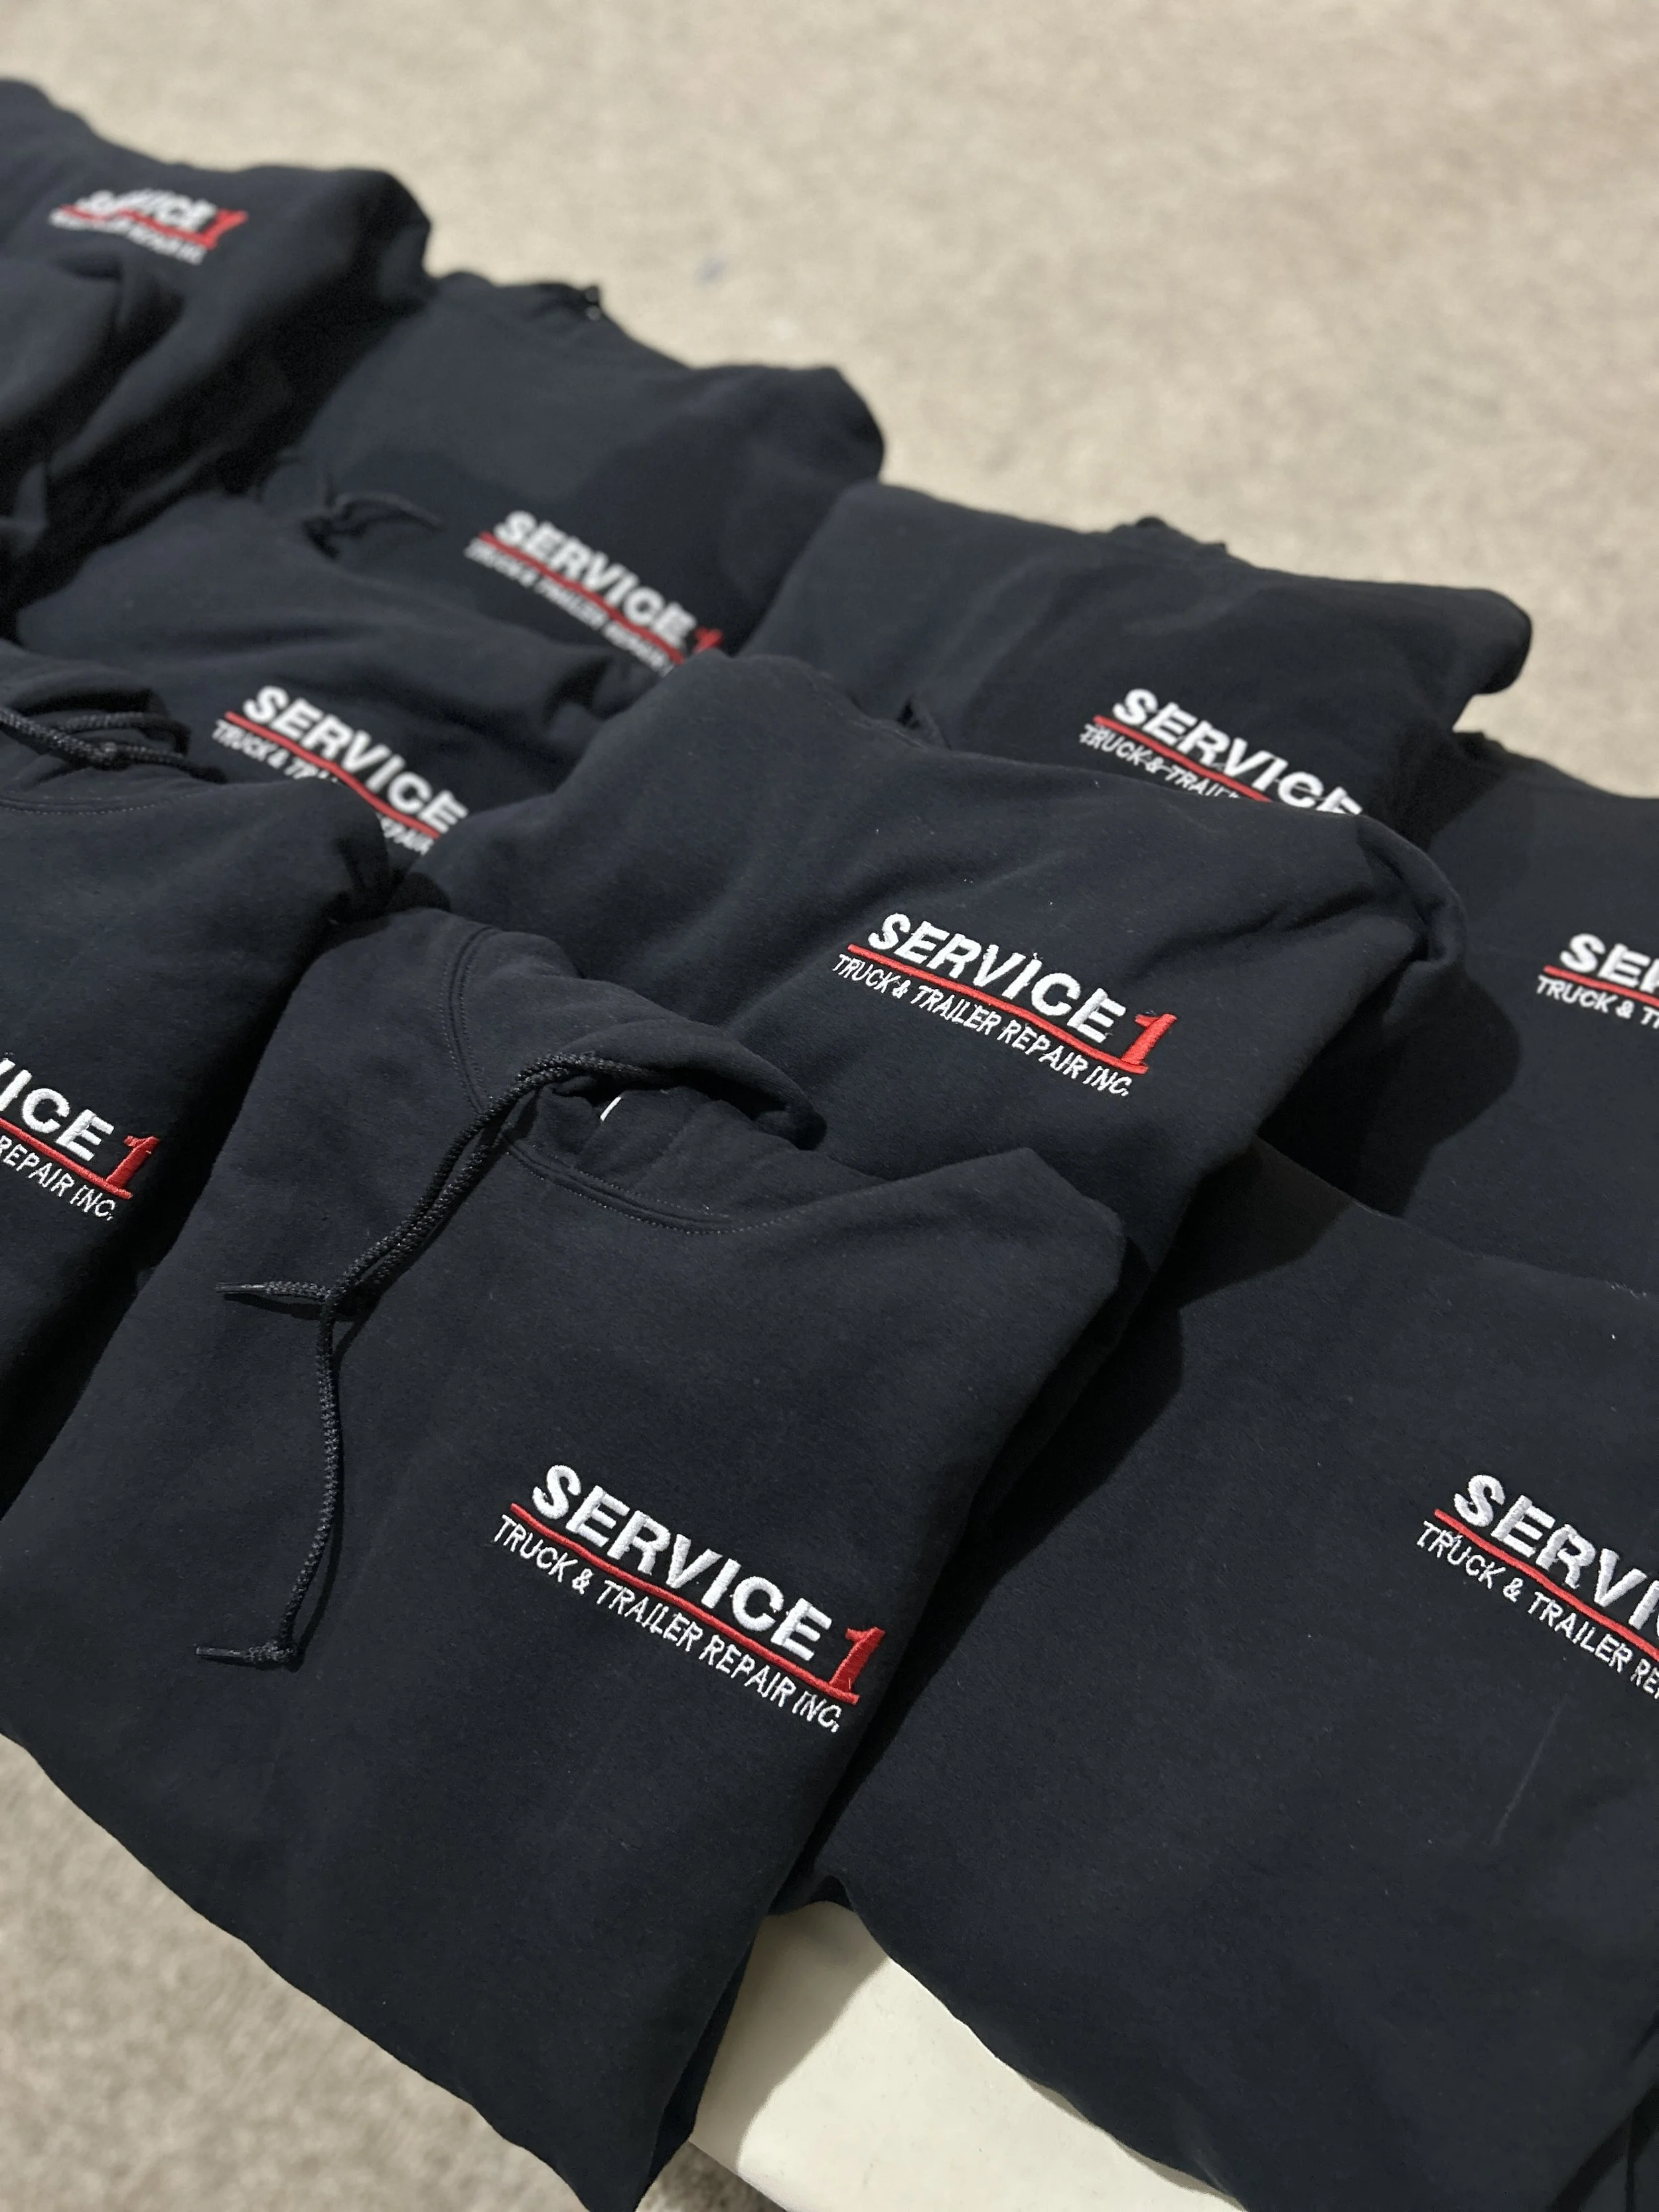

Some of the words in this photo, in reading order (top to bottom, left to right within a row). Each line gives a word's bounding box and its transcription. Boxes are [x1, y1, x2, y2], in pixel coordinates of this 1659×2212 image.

[493, 510, 697, 650] SERVICE
[243, 685, 469, 834] SERVICE
[1080, 723, 1153, 766] TRUCK
[832, 954, 897, 994] TRUCK
[892, 980, 910, 999] &
[910, 985, 1001, 1037] TRAILER
[1000, 1019, 1089, 1080] REPAIR
[1082, 1065, 1132, 1096] INC.
[868, 913, 1127, 1043] SERVICE
[1121, 1013, 1178, 1070] 1
[1536, 975, 1619, 1013] TRUCK
[1615, 999, 1634, 1019] &
[0, 1058, 114, 1161] ICE
[106, 1136, 161, 1197] 1
[494, 1514, 577, 1583] TRUCK
[571, 1568, 595, 1594] &
[597, 1580, 703, 1652] TRAILER
[699, 1634, 796, 1707] REPAIR
[792, 1691, 842, 1733] INC.
[532, 1465, 832, 1661] SERVICE
[830, 1626, 885, 1700] 1
[1417, 1520, 1506, 1589] TRUCK
[1502, 1578, 1524, 1603] &
[1528, 1591, 1633, 1673] TRAILER
[1630, 1659, 1659, 1699] RE
[1453, 1475, 1659, 1637] SERVI
